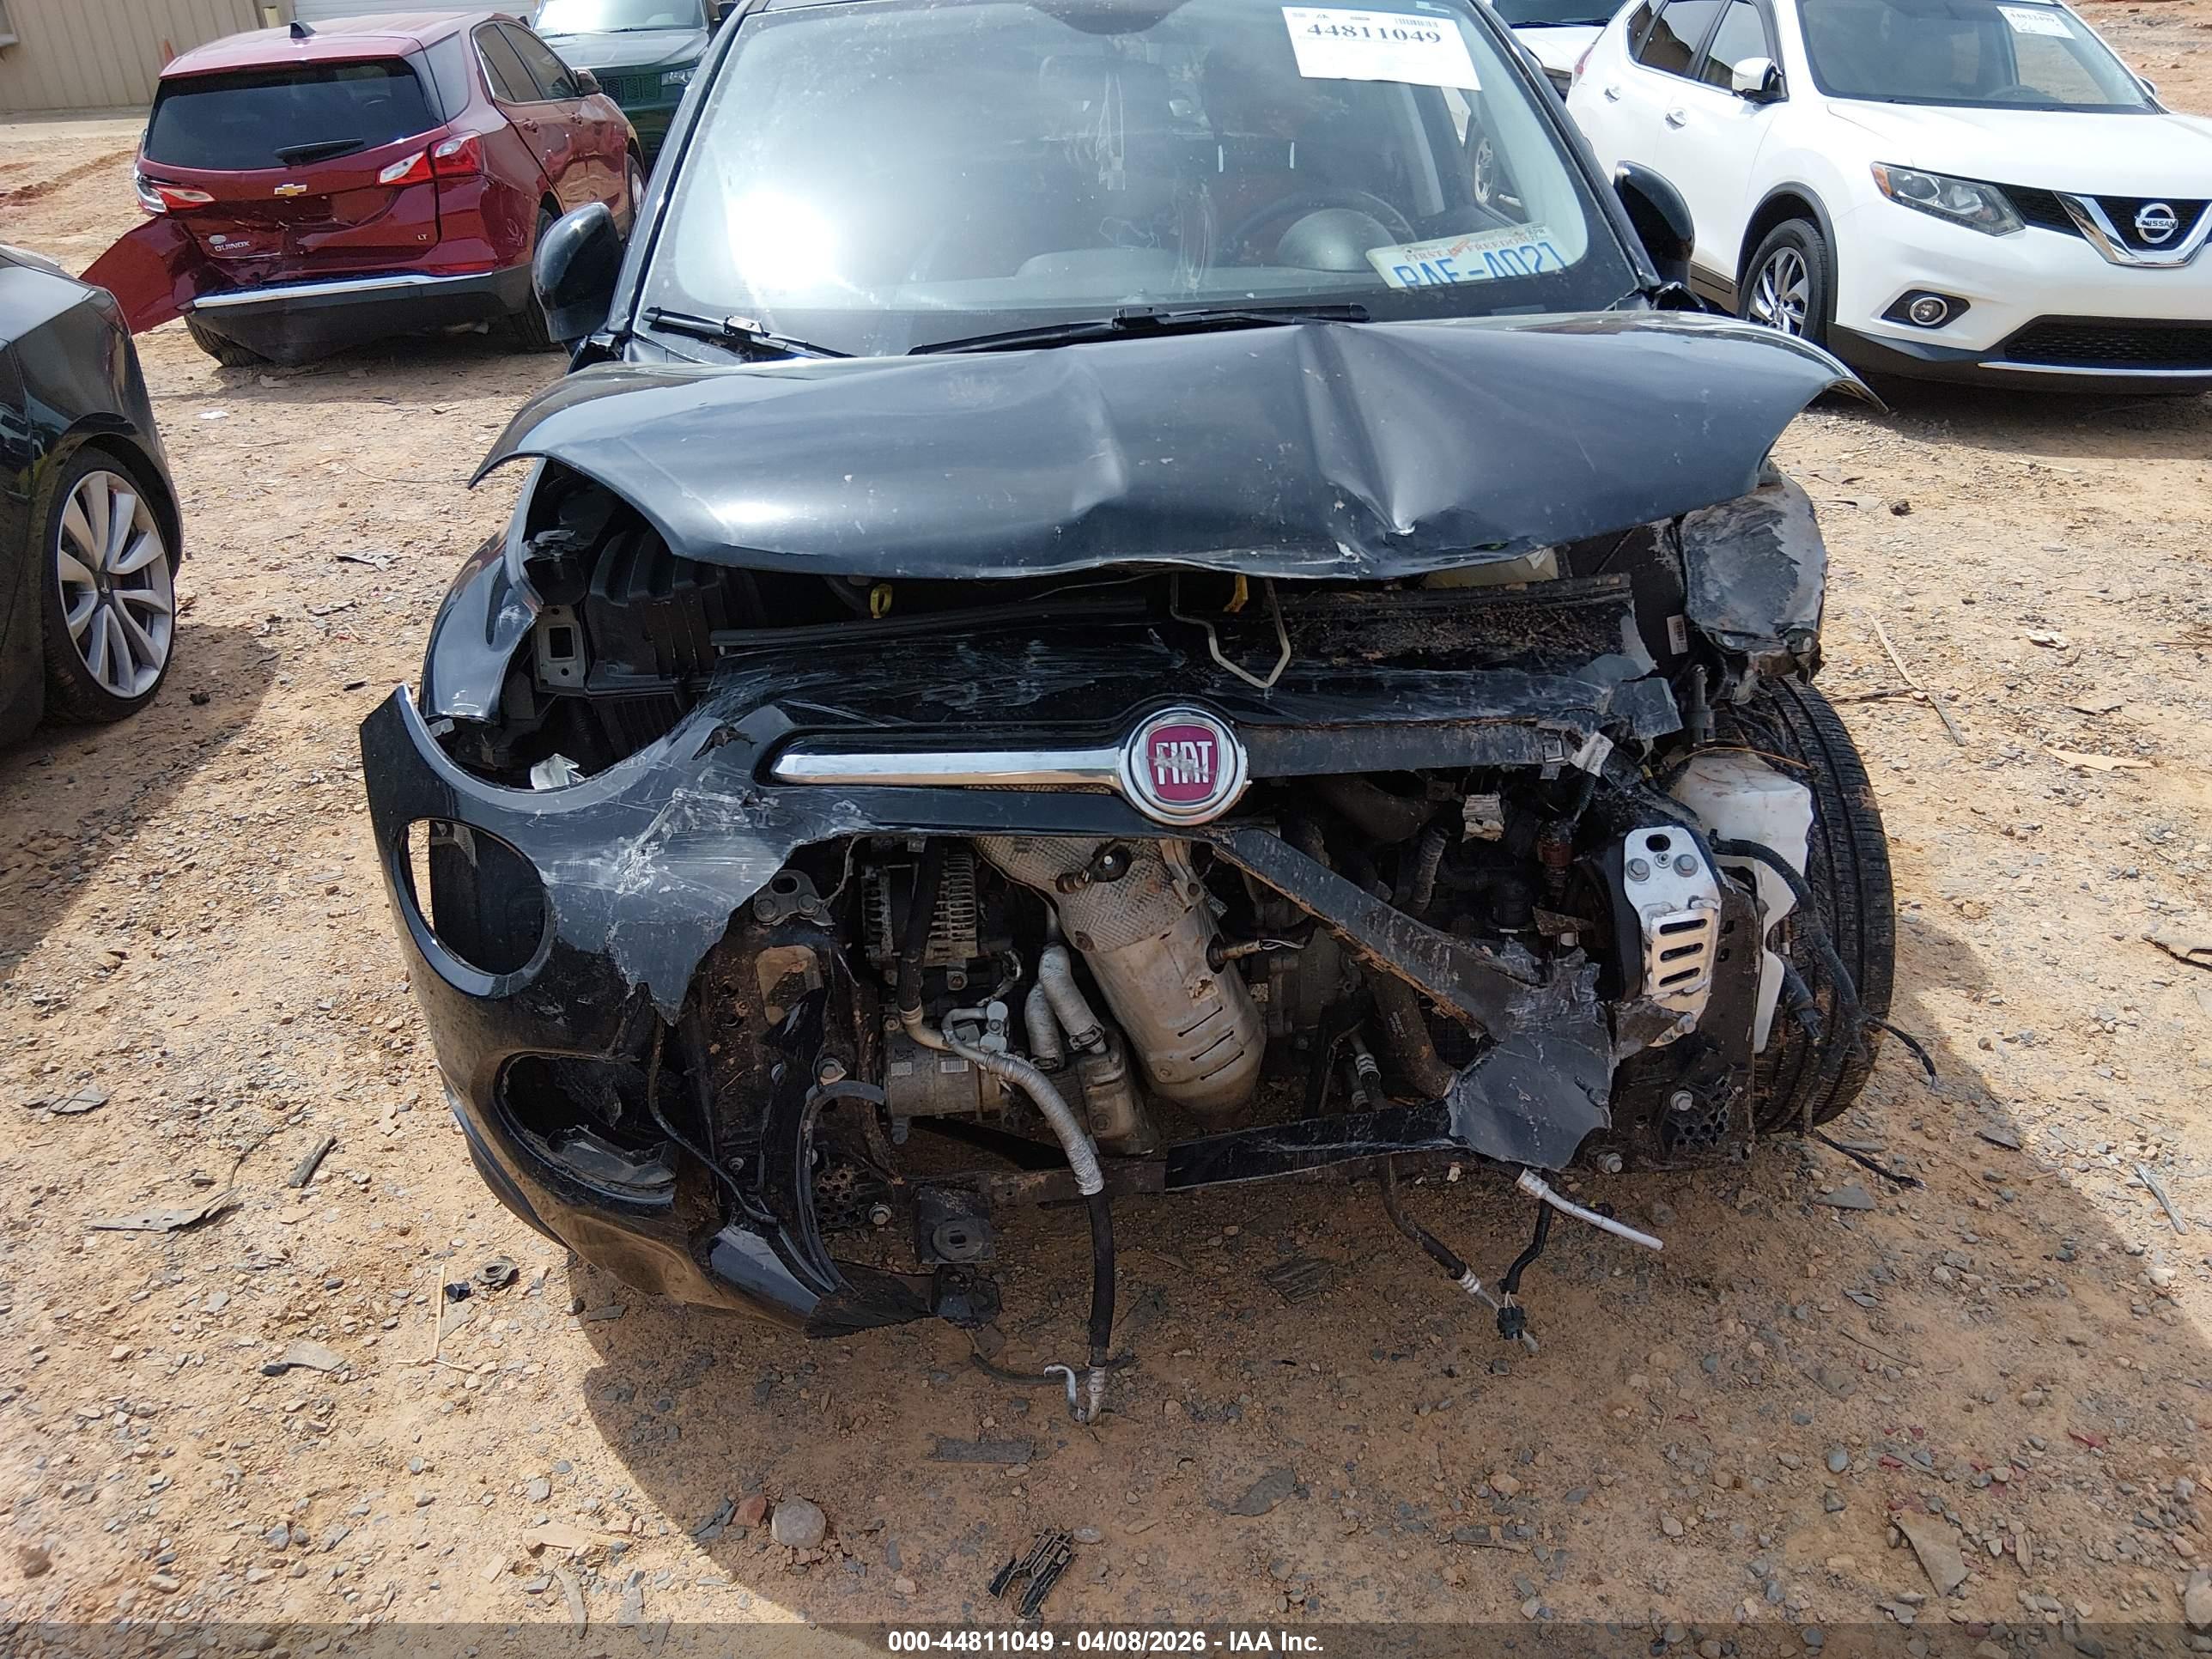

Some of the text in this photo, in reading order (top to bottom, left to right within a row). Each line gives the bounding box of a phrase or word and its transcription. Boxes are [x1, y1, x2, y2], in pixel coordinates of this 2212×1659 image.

[1306, 23, 1441, 43] 44811049
[2142, 220, 2176, 228] NISSAN
[1155, 740, 1212, 786] FIAT
